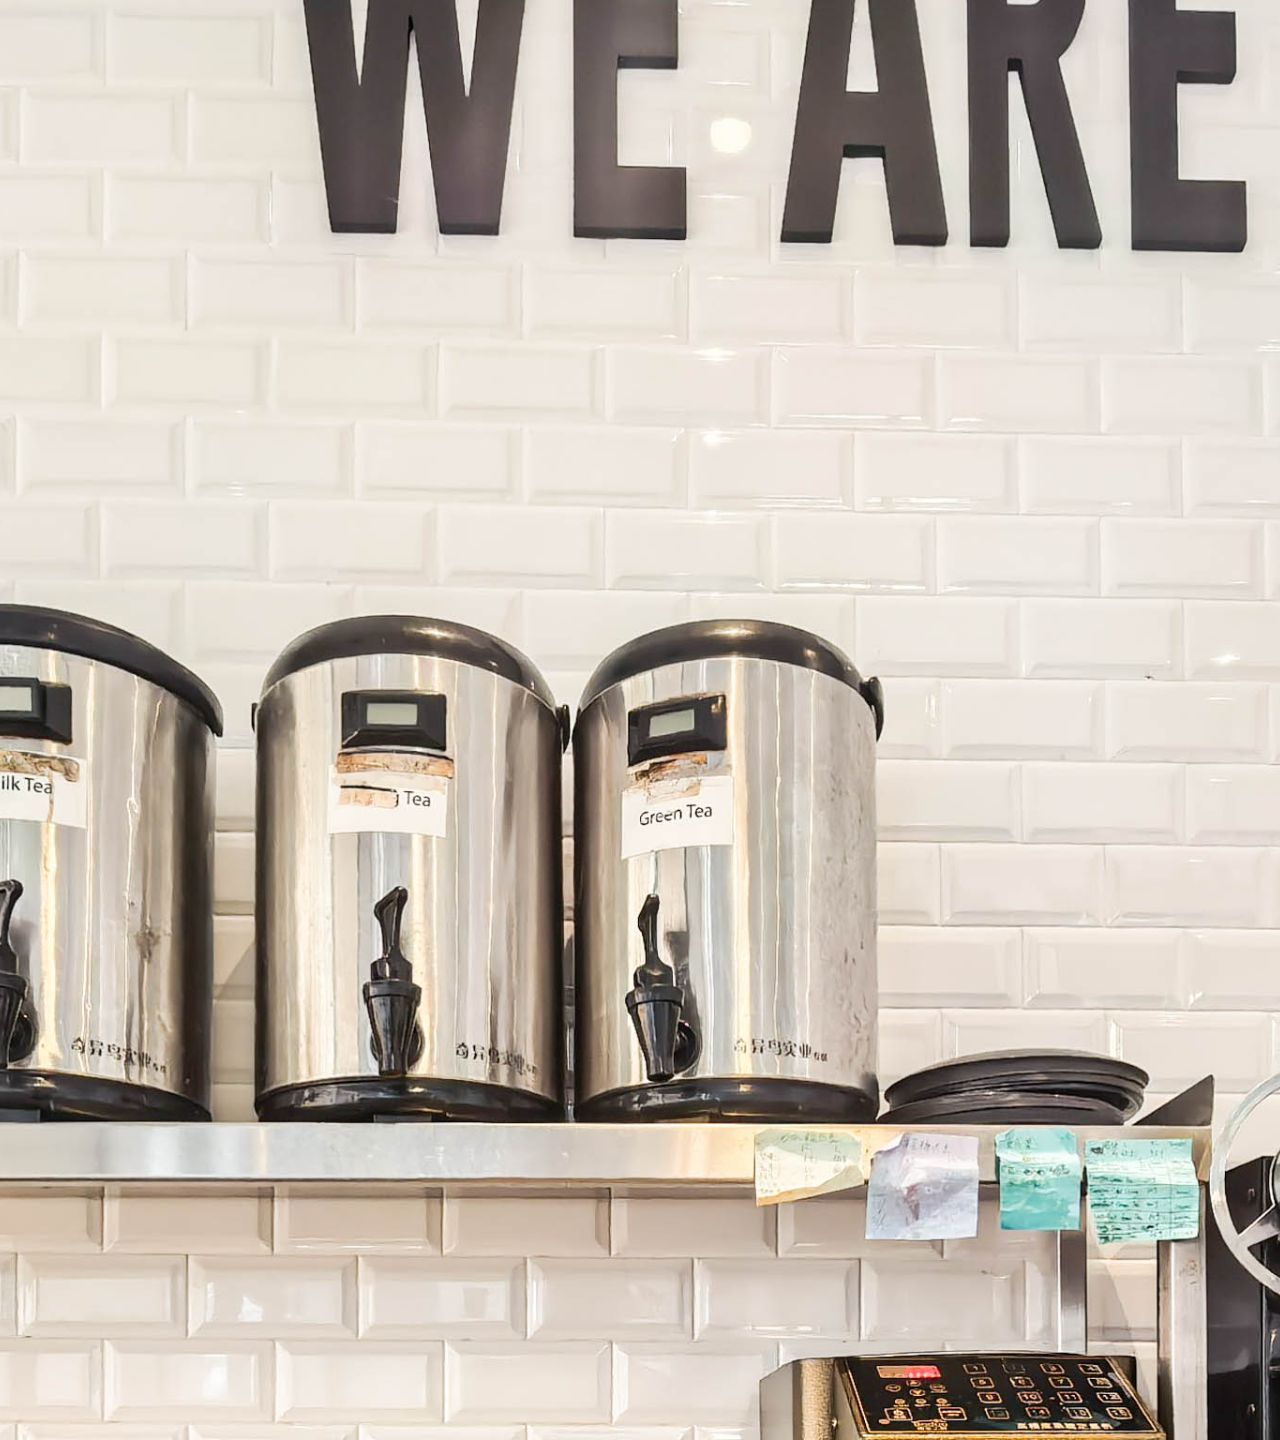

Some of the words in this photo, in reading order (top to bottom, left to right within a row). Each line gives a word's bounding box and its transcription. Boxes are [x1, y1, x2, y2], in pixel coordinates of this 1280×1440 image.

[303, 0, 690, 241] WE
[778, 0, 1250, 254] ARE
[24, 777, 53, 794] Tea
[403, 790, 431, 807] Tea
[639, 809, 683, 826] Green
[686, 803, 713, 818] Tea
